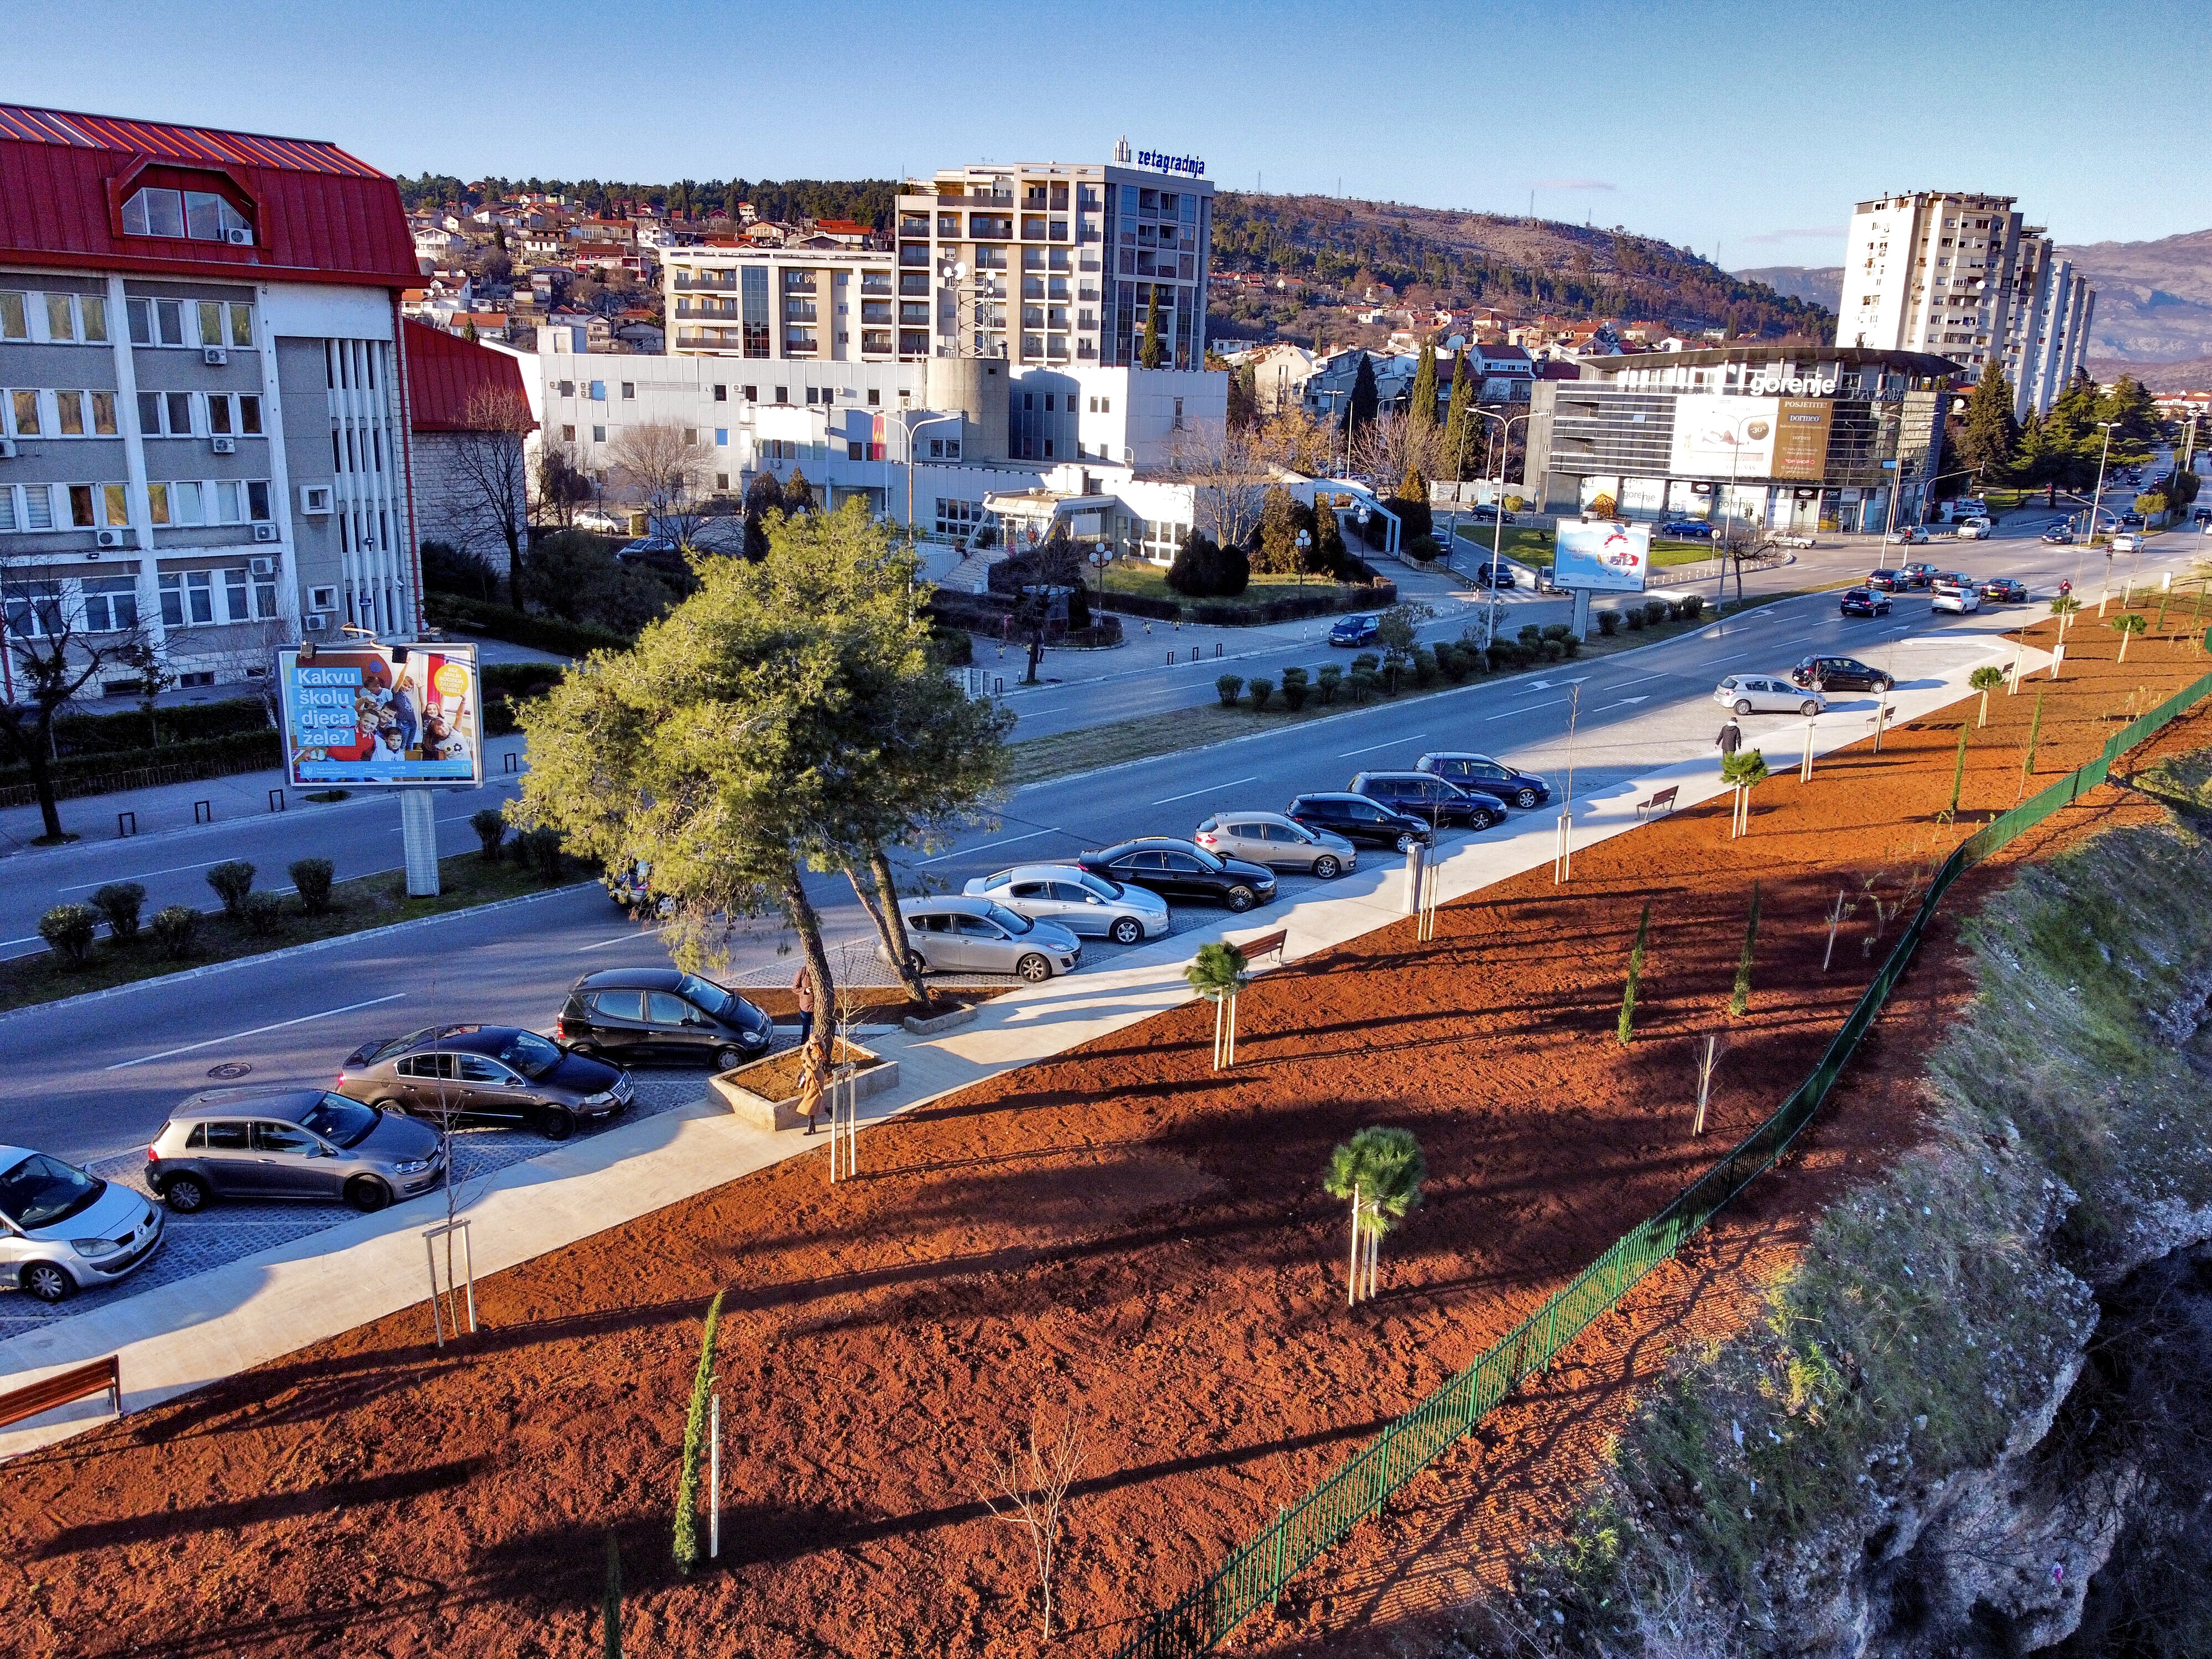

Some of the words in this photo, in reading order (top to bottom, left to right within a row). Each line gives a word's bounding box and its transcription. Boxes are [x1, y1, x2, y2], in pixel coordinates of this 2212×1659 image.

[1138, 149, 1206, 178] zetagradnja
[1750, 374, 1835, 397] gorenje
[1623, 490, 1655, 502] gorenje
[1717, 499, 1755, 509] gorenje
[298, 669, 356, 685] Kakvu
[300, 690, 349, 705] školu
[301, 710, 350, 728] djeca
[303, 729, 349, 745] žele?
